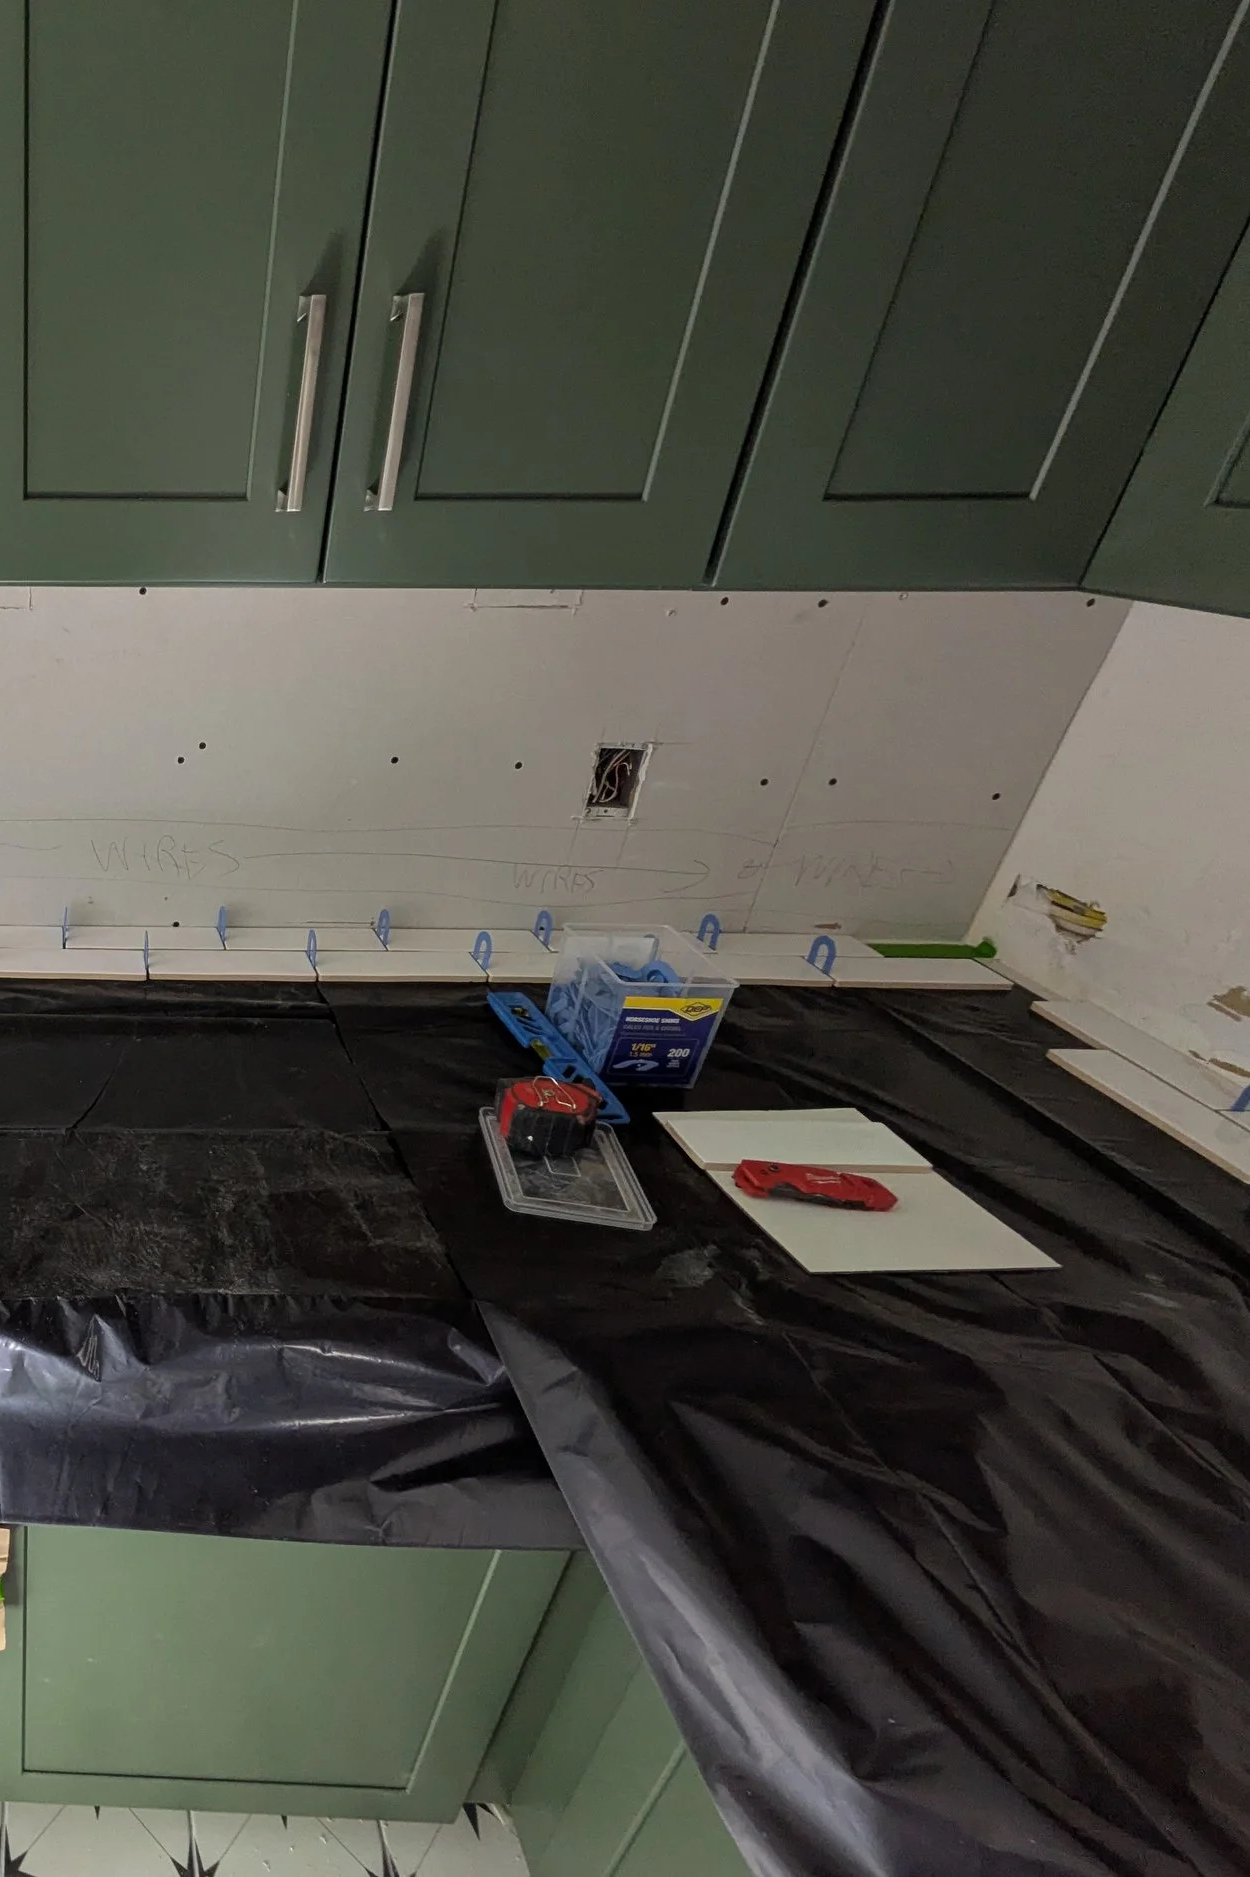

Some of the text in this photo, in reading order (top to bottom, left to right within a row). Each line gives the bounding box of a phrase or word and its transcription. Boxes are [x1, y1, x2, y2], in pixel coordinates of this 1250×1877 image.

[91, 834, 241, 881] WIRES
[512, 863, 604, 893] WIRES
[667, 1048, 690, 1057] 200
